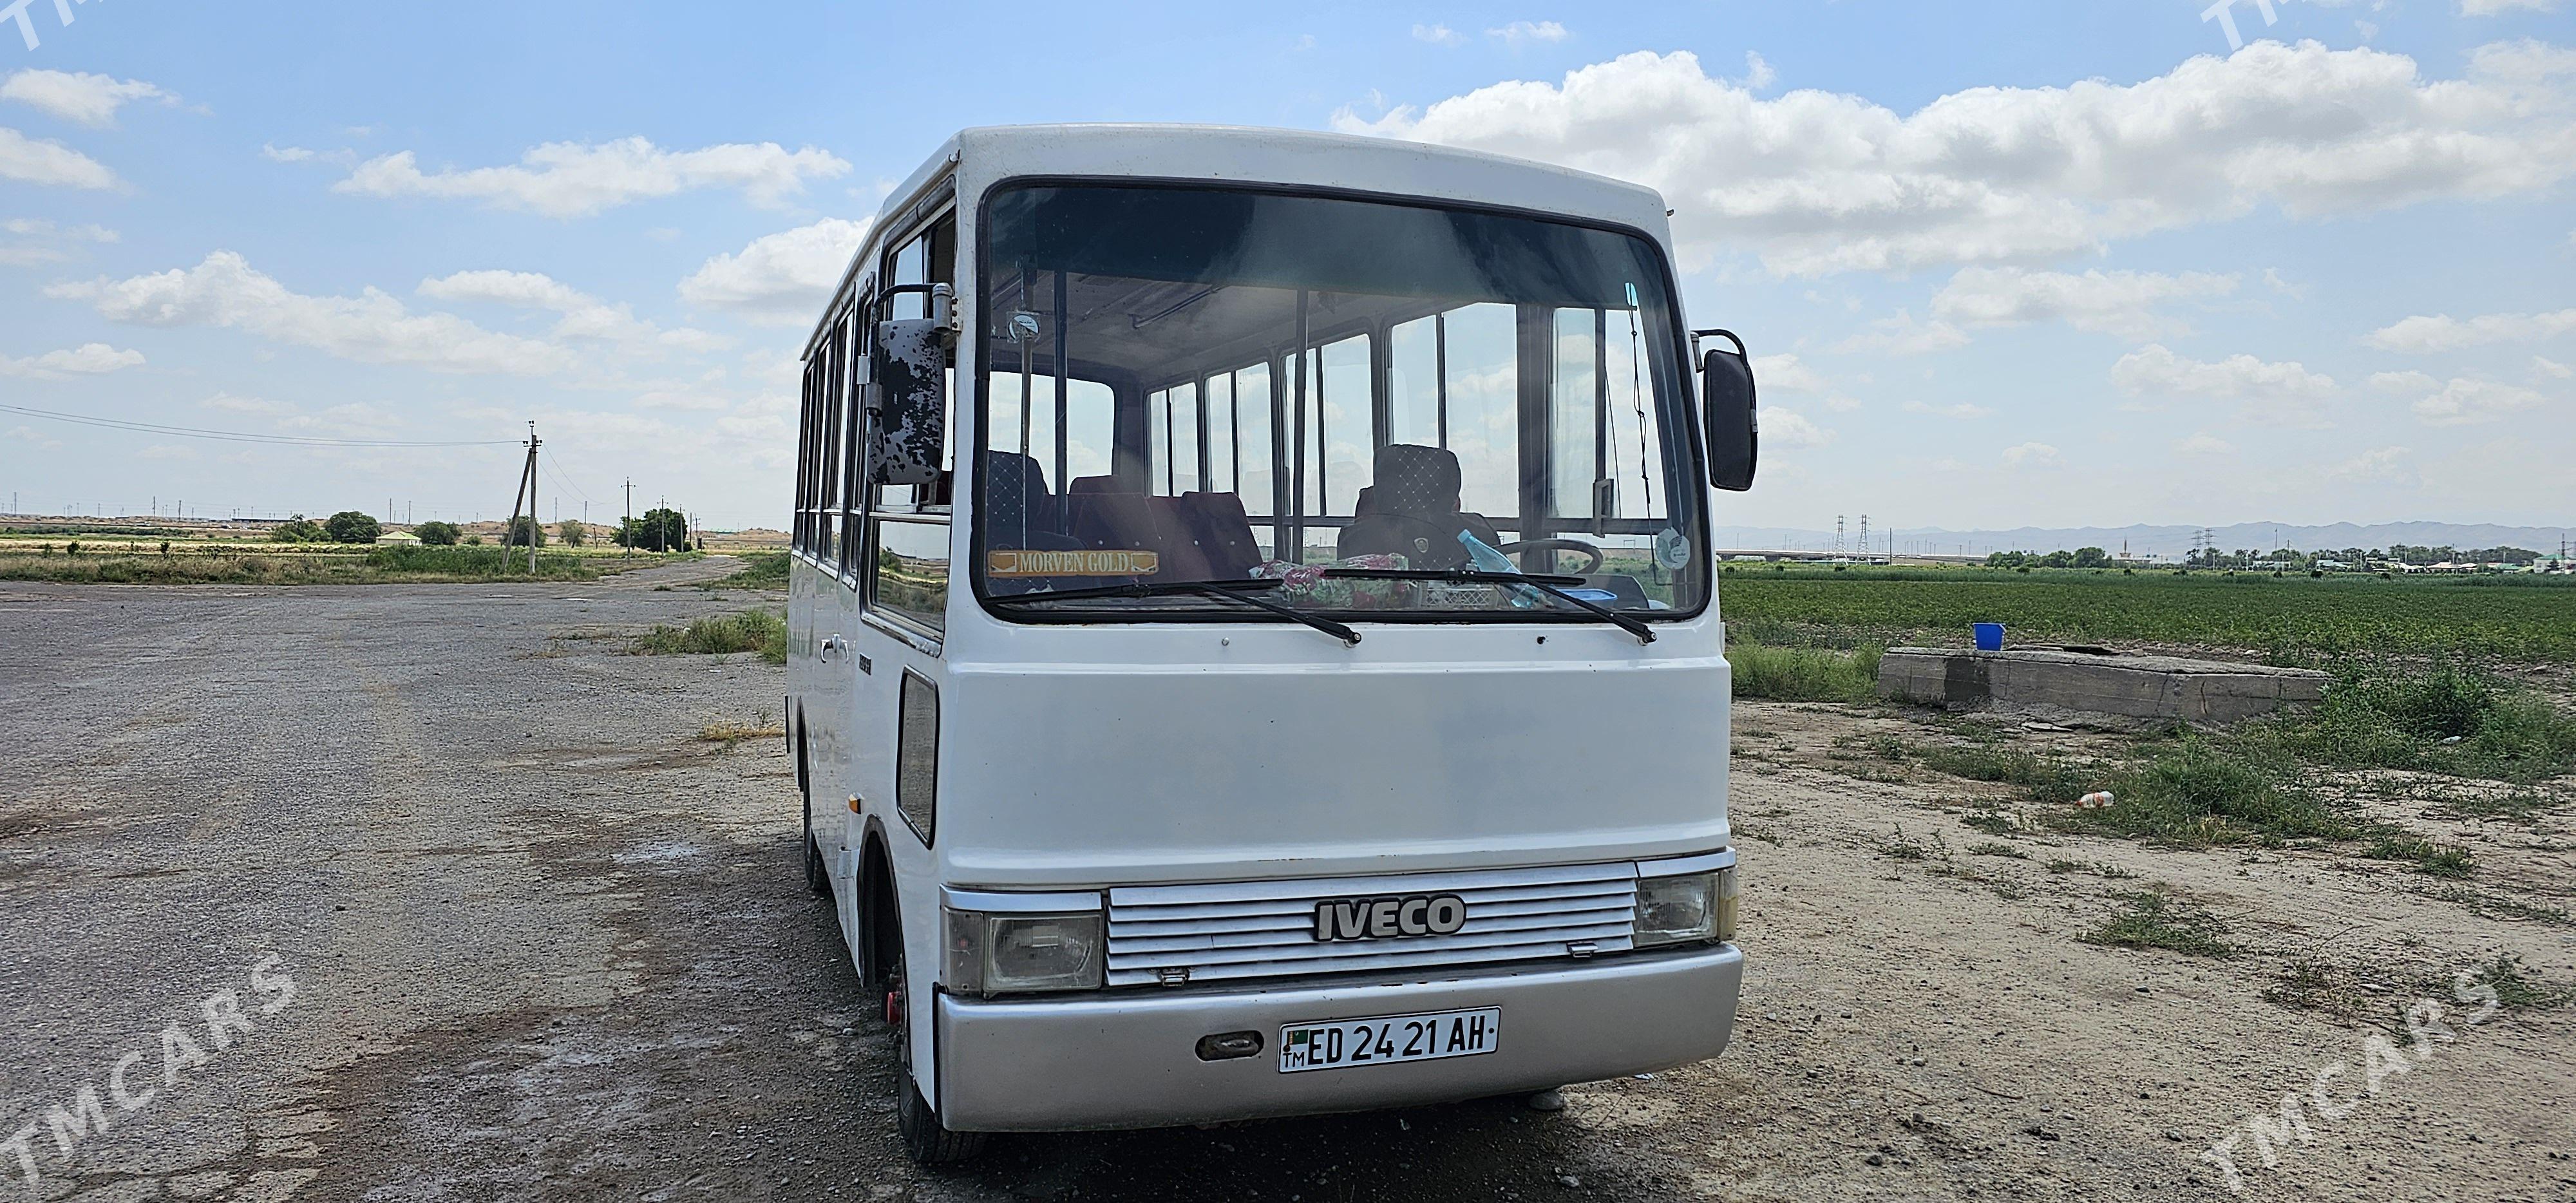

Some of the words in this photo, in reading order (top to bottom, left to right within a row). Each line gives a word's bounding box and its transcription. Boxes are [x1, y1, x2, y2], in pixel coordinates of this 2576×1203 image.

[1020, 553, 1084, 573] MORVEN
[1088, 553, 1128, 572] GOLD
[1318, 896, 1465, 940] IVECO
[1307, 1027, 1343, 1066] ED
[1351, 1023, 1394, 1061] 24
[1402, 1019, 1437, 1057] 21
[1446, 1015, 1486, 1052] AH
[1282, 1051, 1305, 1068] TM
